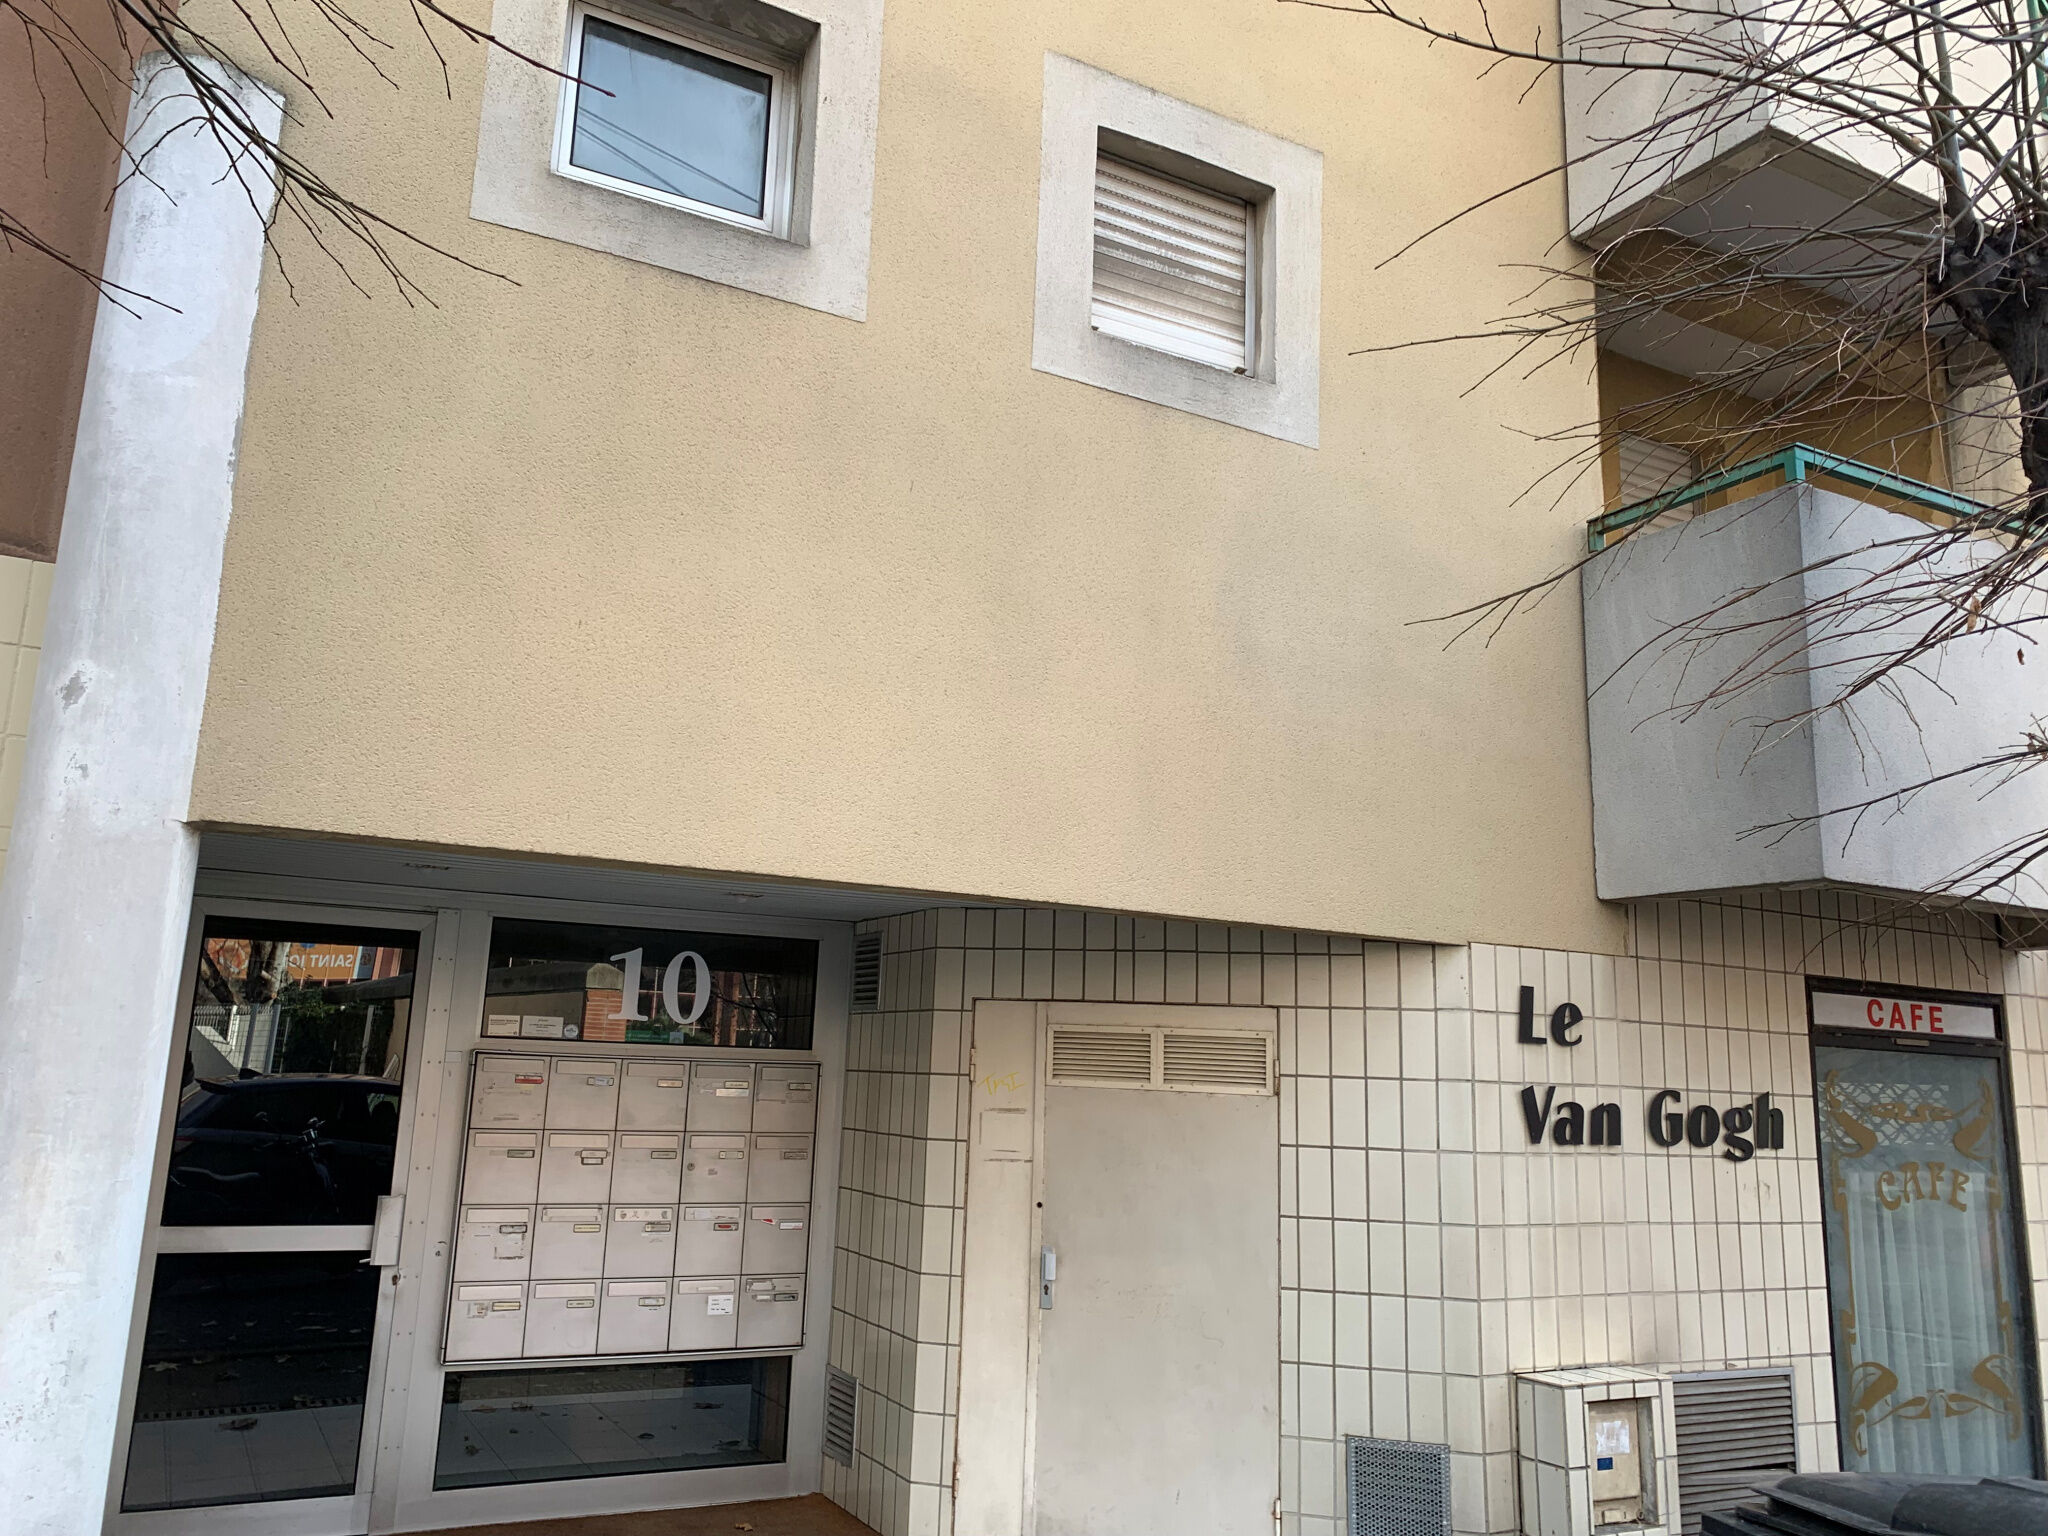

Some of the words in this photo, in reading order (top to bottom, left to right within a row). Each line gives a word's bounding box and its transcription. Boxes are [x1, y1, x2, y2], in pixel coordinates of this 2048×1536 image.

[608, 947, 711, 1025] 10
[1519, 985, 1584, 1047] Le
[1866, 998, 1944, 1034] CAFE
[1521, 1085, 1622, 1146] Van
[1650, 1090, 1784, 1162] Gogh
[1877, 1161, 1970, 1212] CAFE
